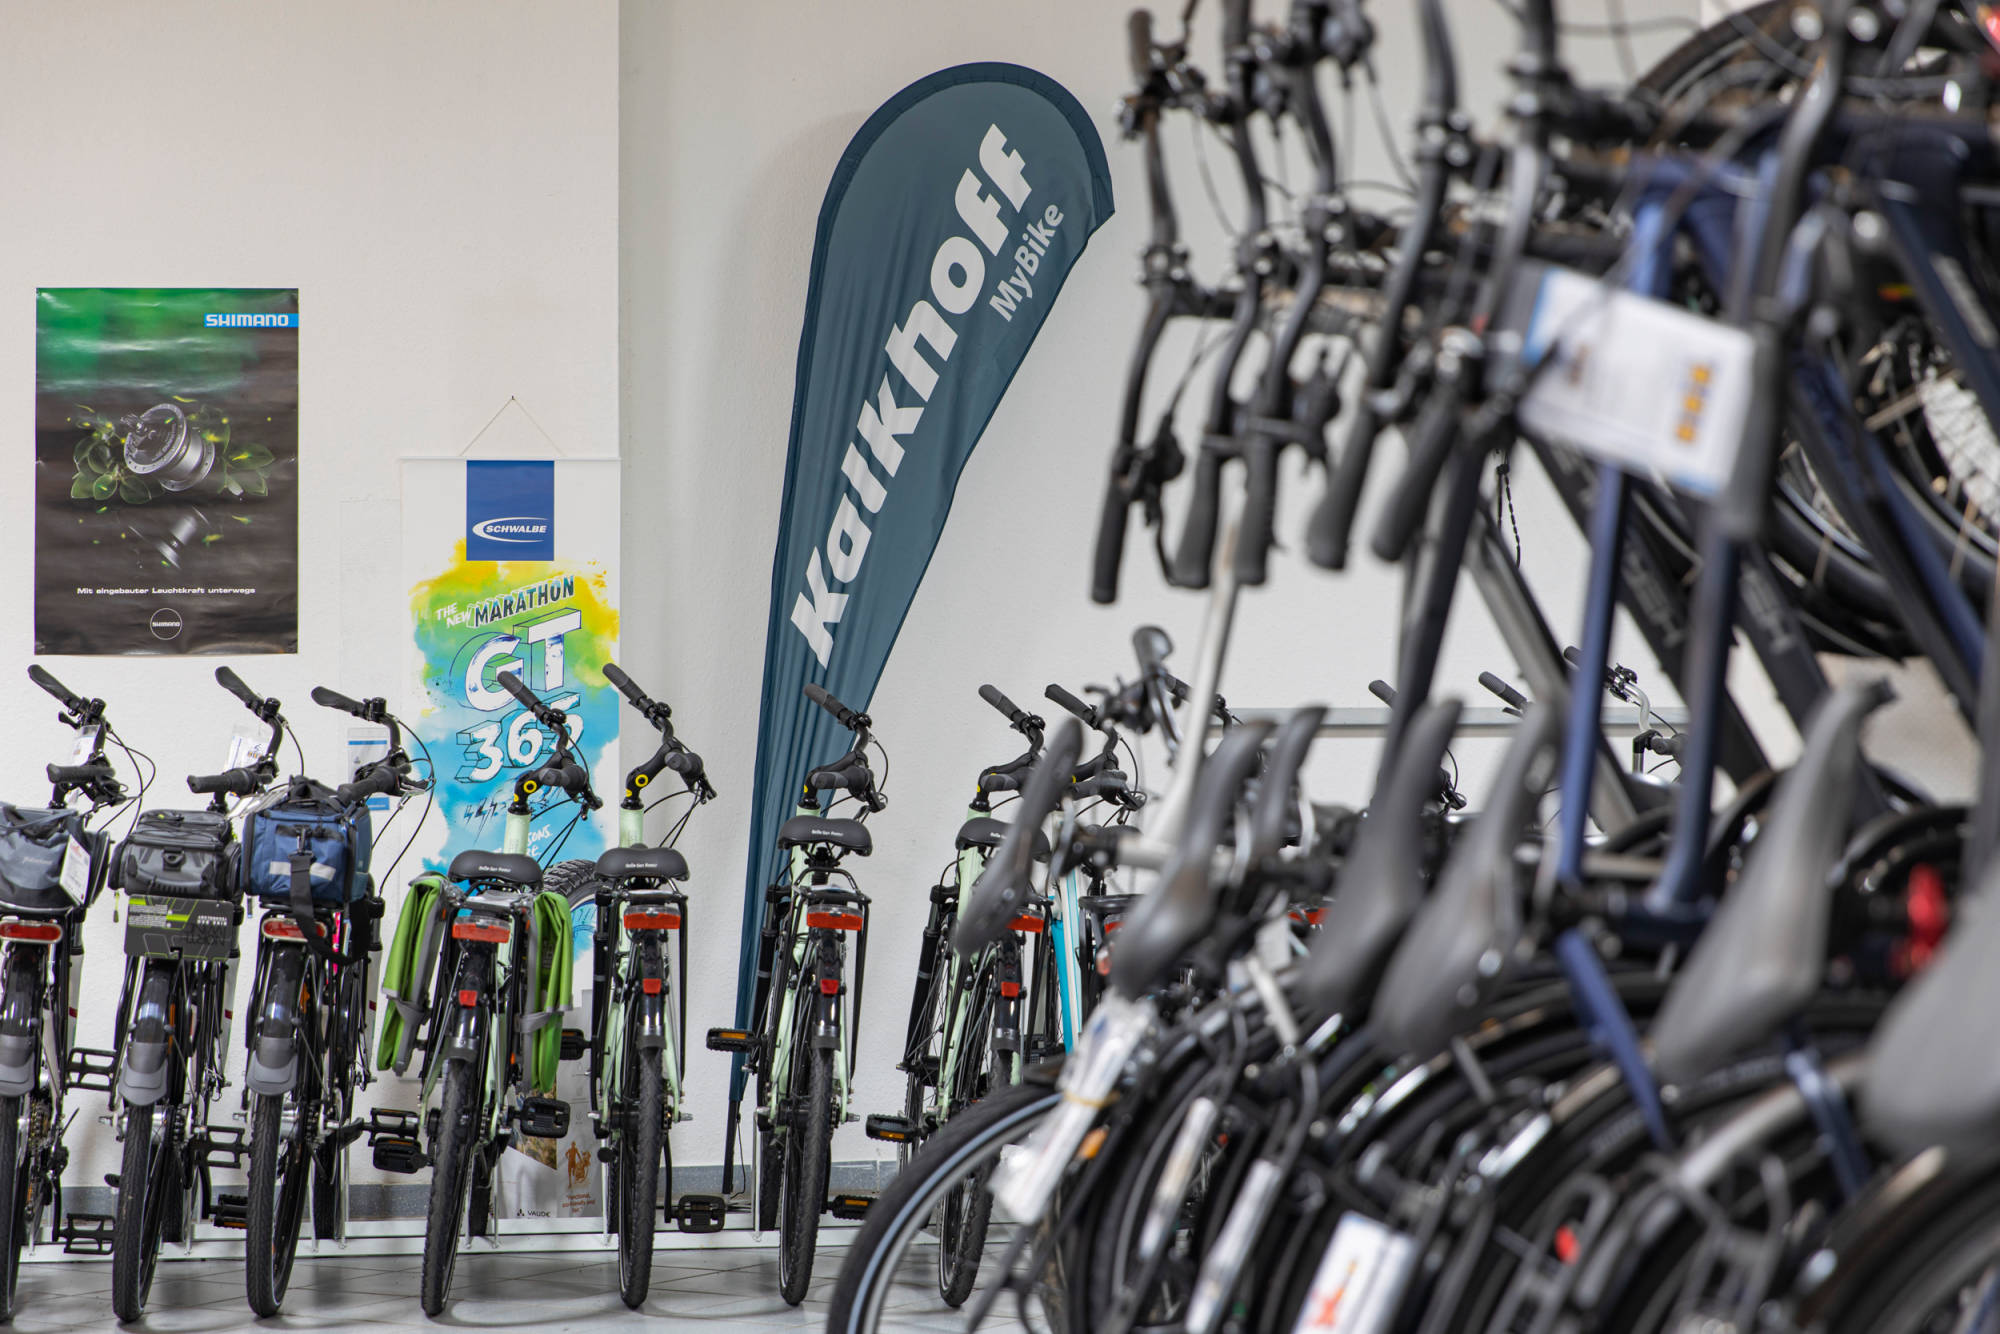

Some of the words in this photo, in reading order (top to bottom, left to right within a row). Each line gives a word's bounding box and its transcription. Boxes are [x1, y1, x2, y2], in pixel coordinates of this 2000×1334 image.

[989, 204, 1064, 322] MyBike
[206, 314, 289, 327] SHIMANO
[790, 123, 1032, 670] Kalkhoff
[486, 525, 547, 533] SCHWALBE
[77, 587, 93, 595] Mit
[96, 587, 149, 596] eingebauter
[152, 587, 205, 595] Leuchtkraft
[207, 588, 256, 596] unterwegs
[473, 575, 575, 628] MARATHON
[436, 602, 458, 621] THE
[446, 609, 472, 629] NEW
